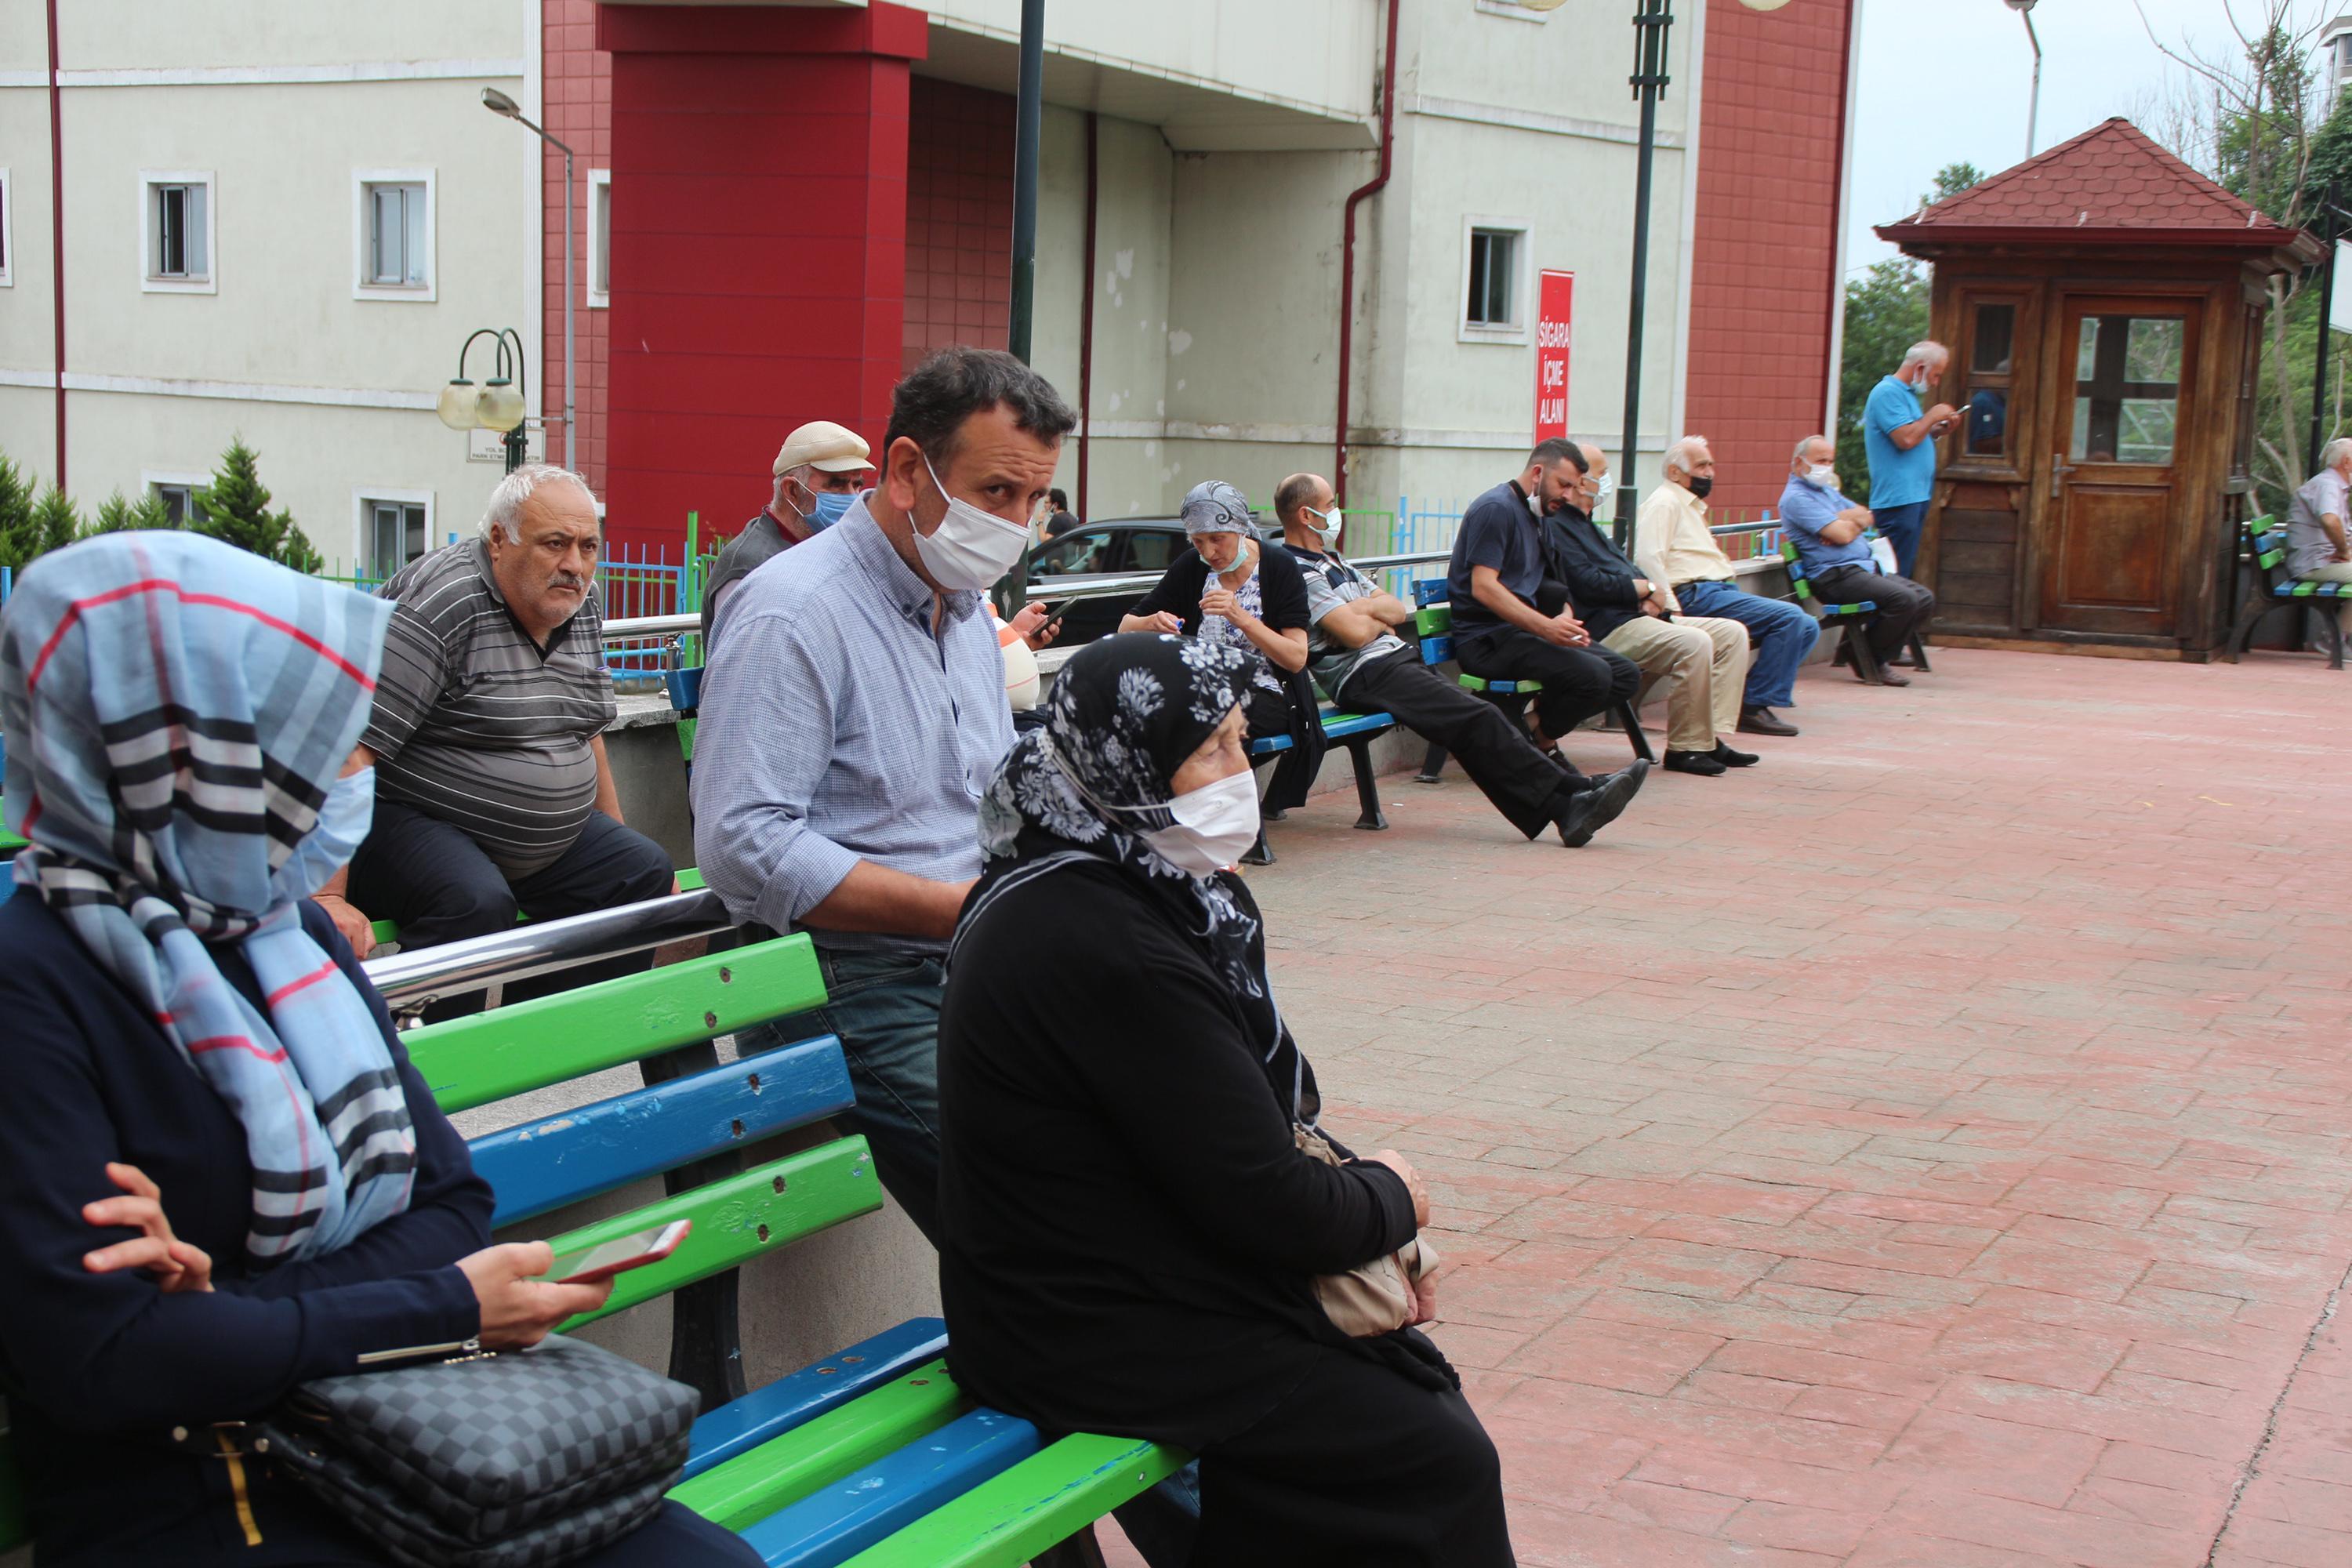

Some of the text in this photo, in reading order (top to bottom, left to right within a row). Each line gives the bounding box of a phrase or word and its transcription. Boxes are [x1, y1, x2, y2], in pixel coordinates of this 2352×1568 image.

[1539, 315, 1570, 348] SİGARA
[1543, 354, 1564, 393] İÇME
[1539, 398, 1565, 424] ALANI
